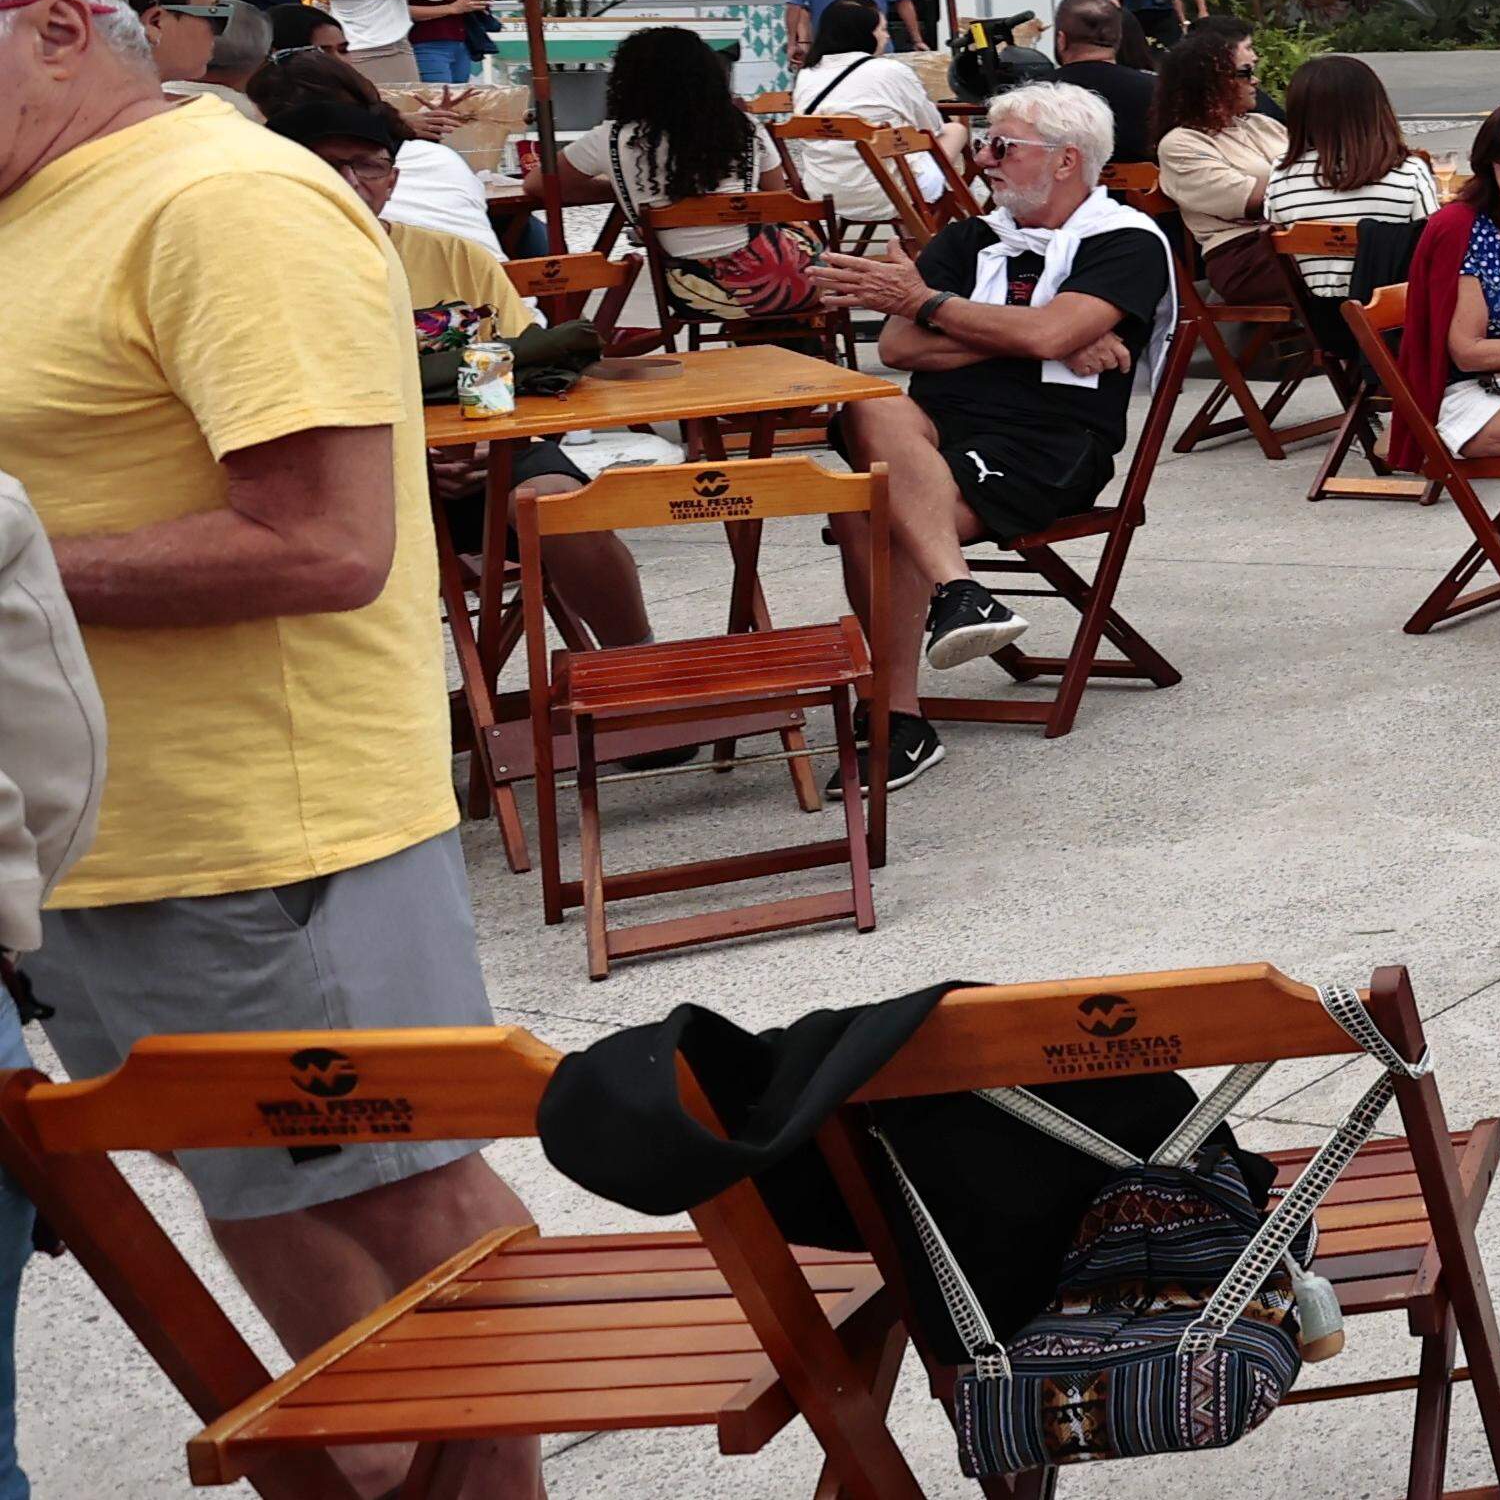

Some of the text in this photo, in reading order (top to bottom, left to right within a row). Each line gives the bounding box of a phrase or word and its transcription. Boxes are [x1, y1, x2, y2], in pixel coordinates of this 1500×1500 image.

[668, 496, 753, 509] WELL FESTAS
[1042, 1034, 1182, 1057] WELL FESTAS
[256, 1098, 413, 1116] WELL FESTAS
